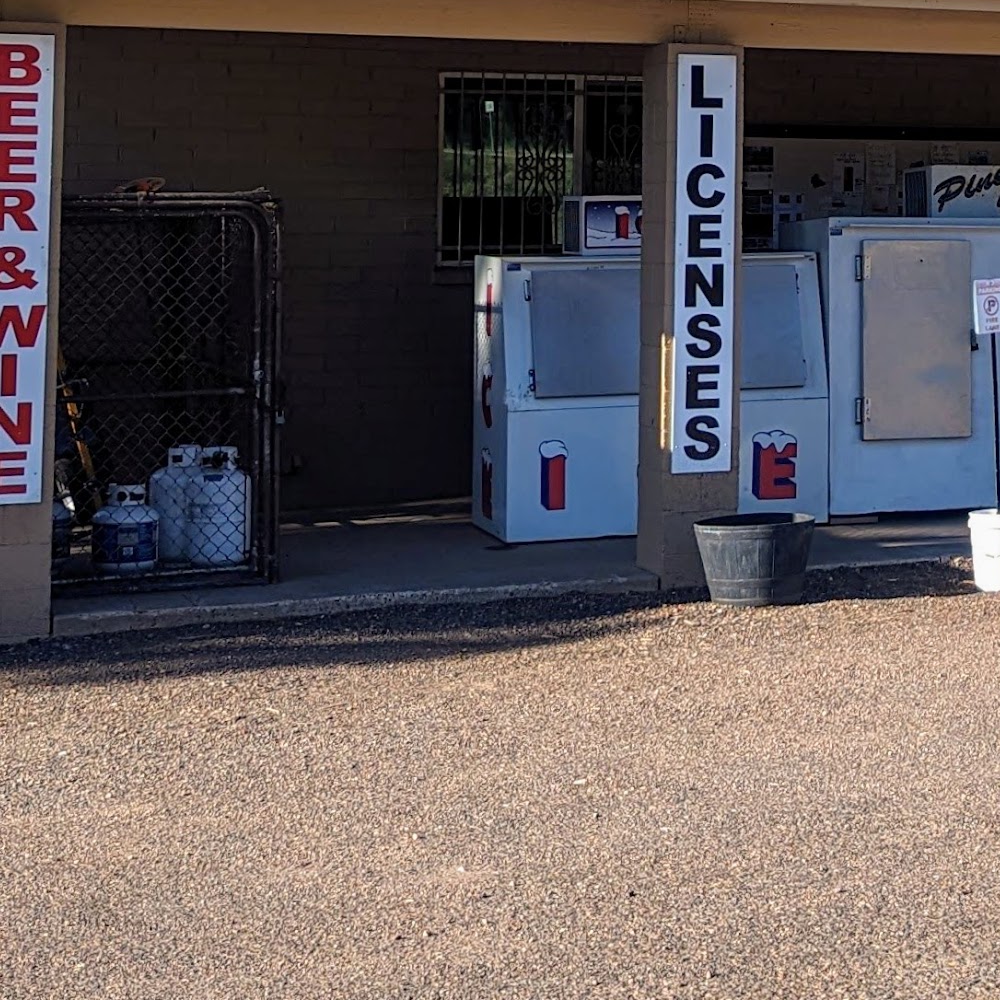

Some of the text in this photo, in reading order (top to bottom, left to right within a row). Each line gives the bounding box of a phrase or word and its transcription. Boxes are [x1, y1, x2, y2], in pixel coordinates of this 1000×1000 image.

[0, 43, 42, 231] BEER
[0, 246, 39, 289] &
[684, 64, 725, 461] LICENSES
